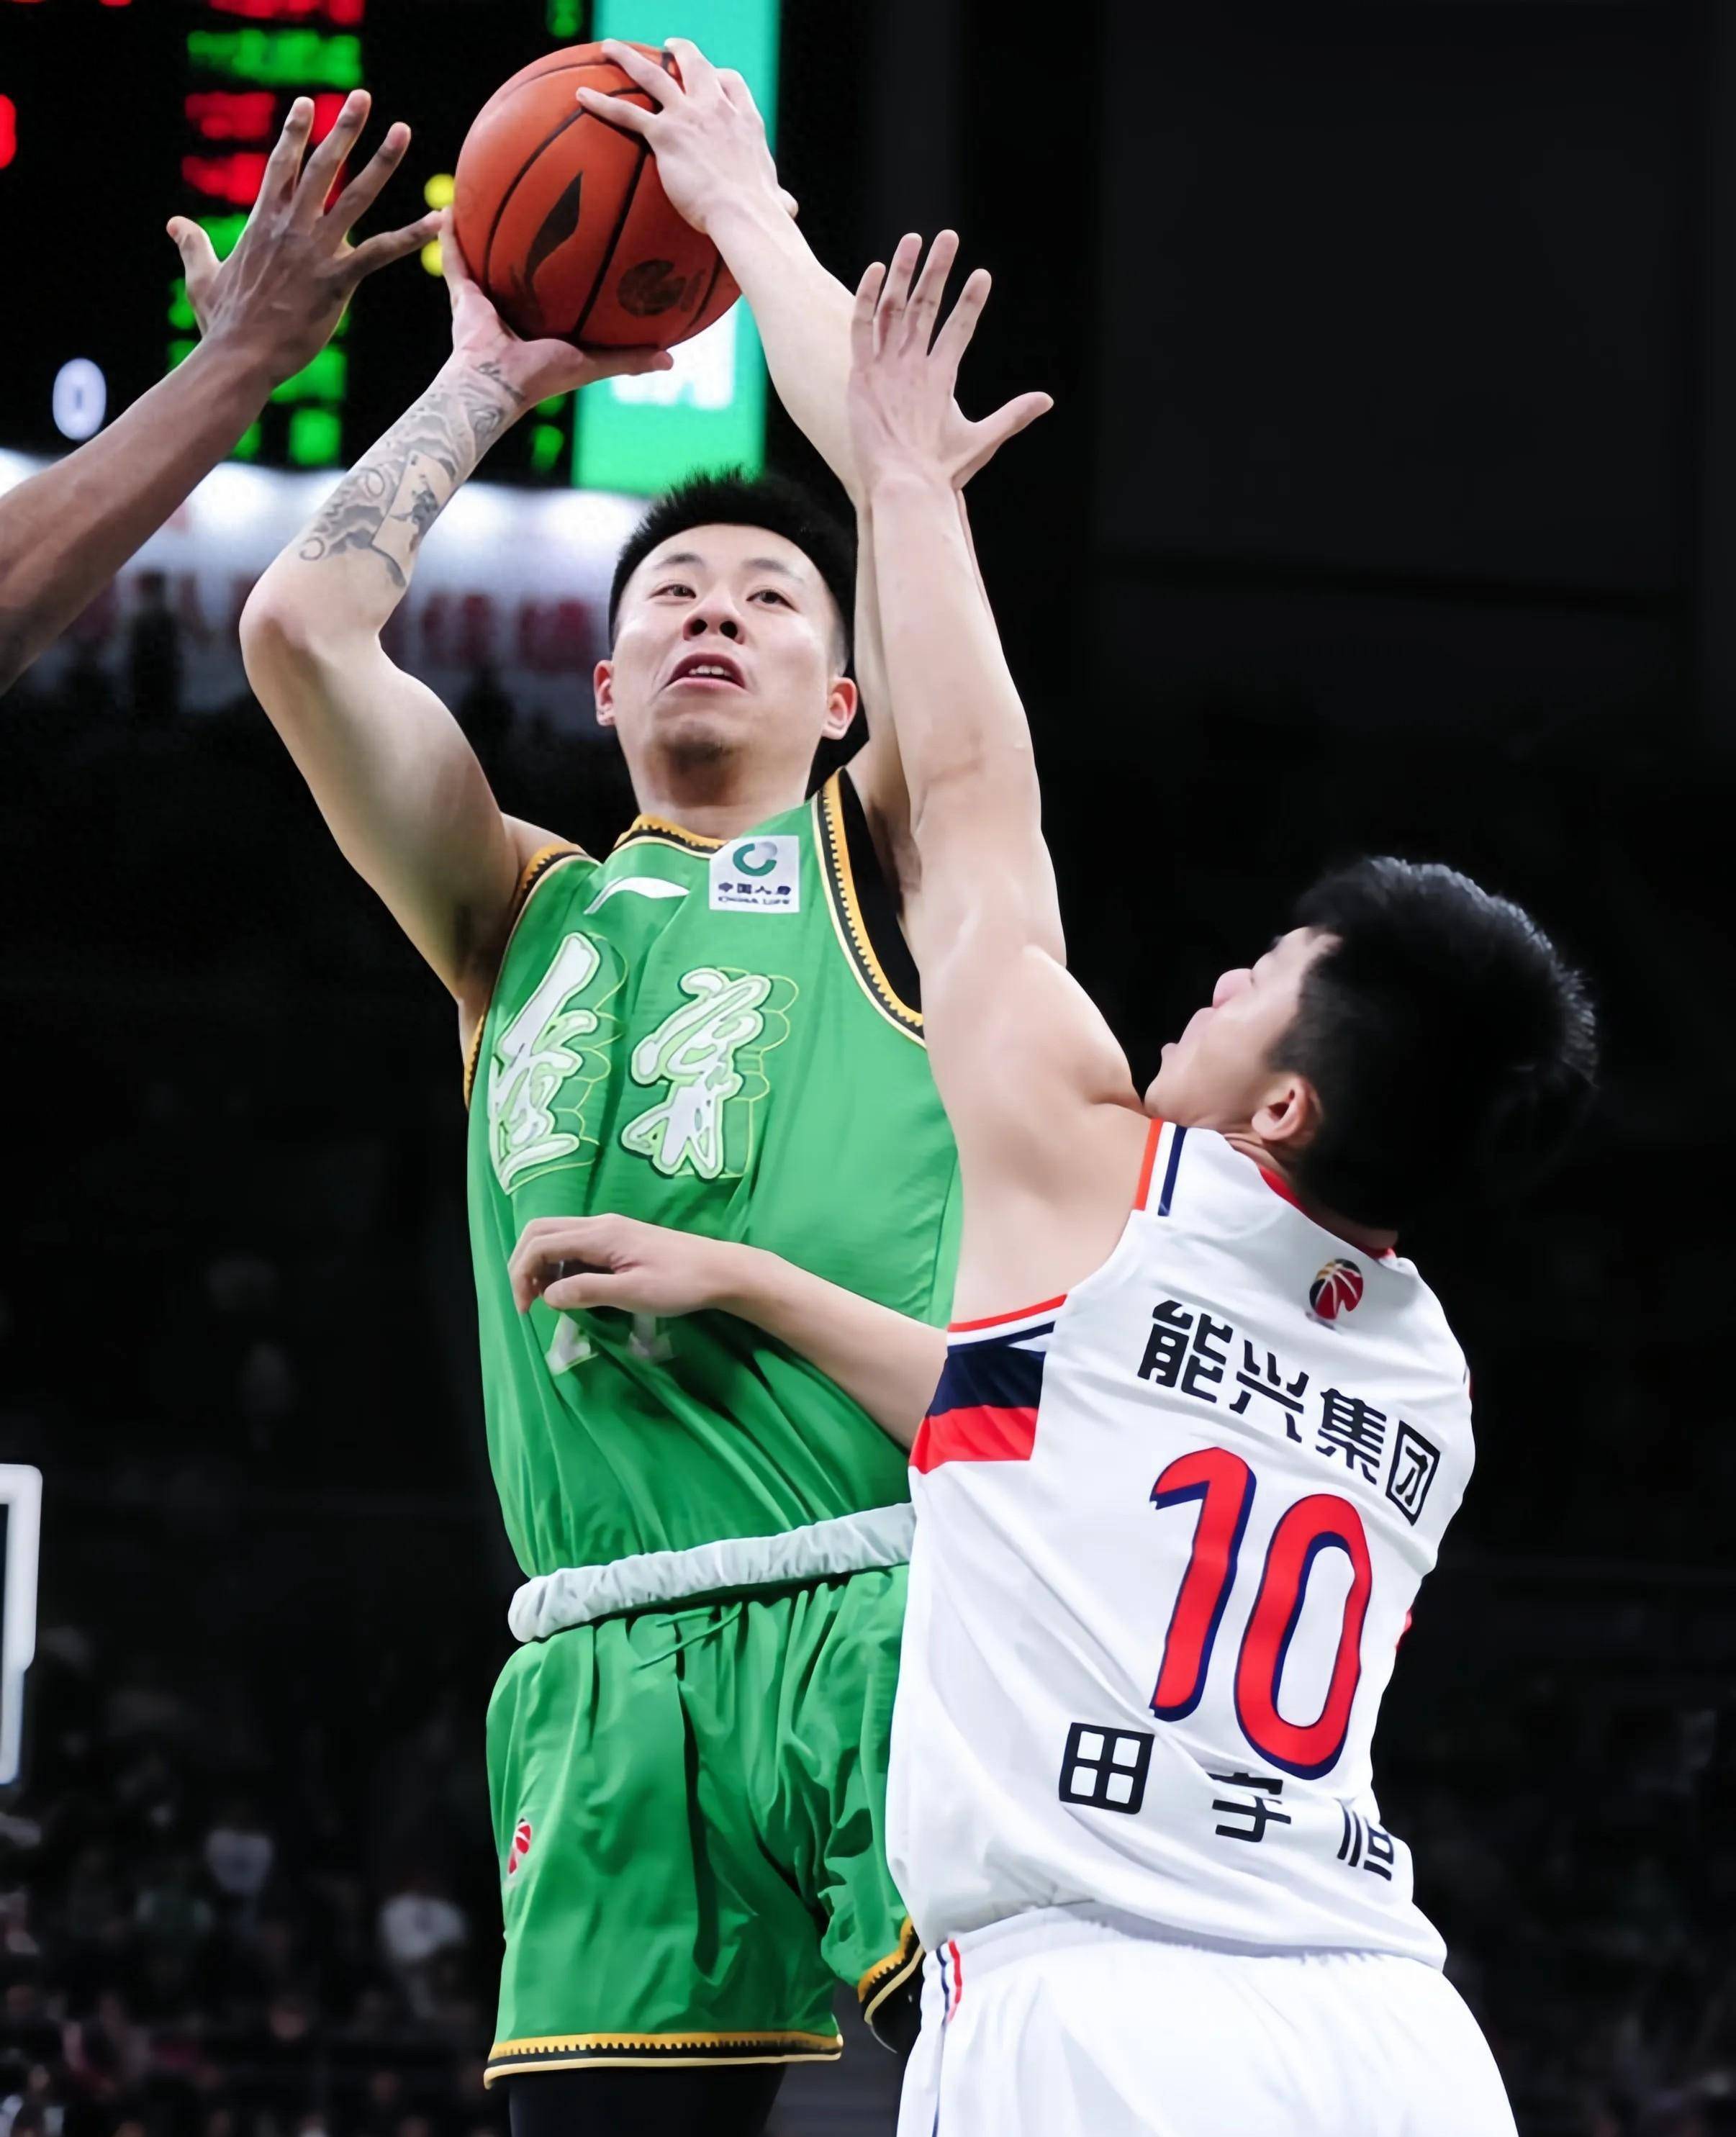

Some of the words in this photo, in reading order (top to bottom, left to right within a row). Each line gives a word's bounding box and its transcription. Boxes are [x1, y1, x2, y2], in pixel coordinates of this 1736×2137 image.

[1137, 1299, 1441, 1526] 能兴集团
[1149, 1447, 1373, 1780] 10
